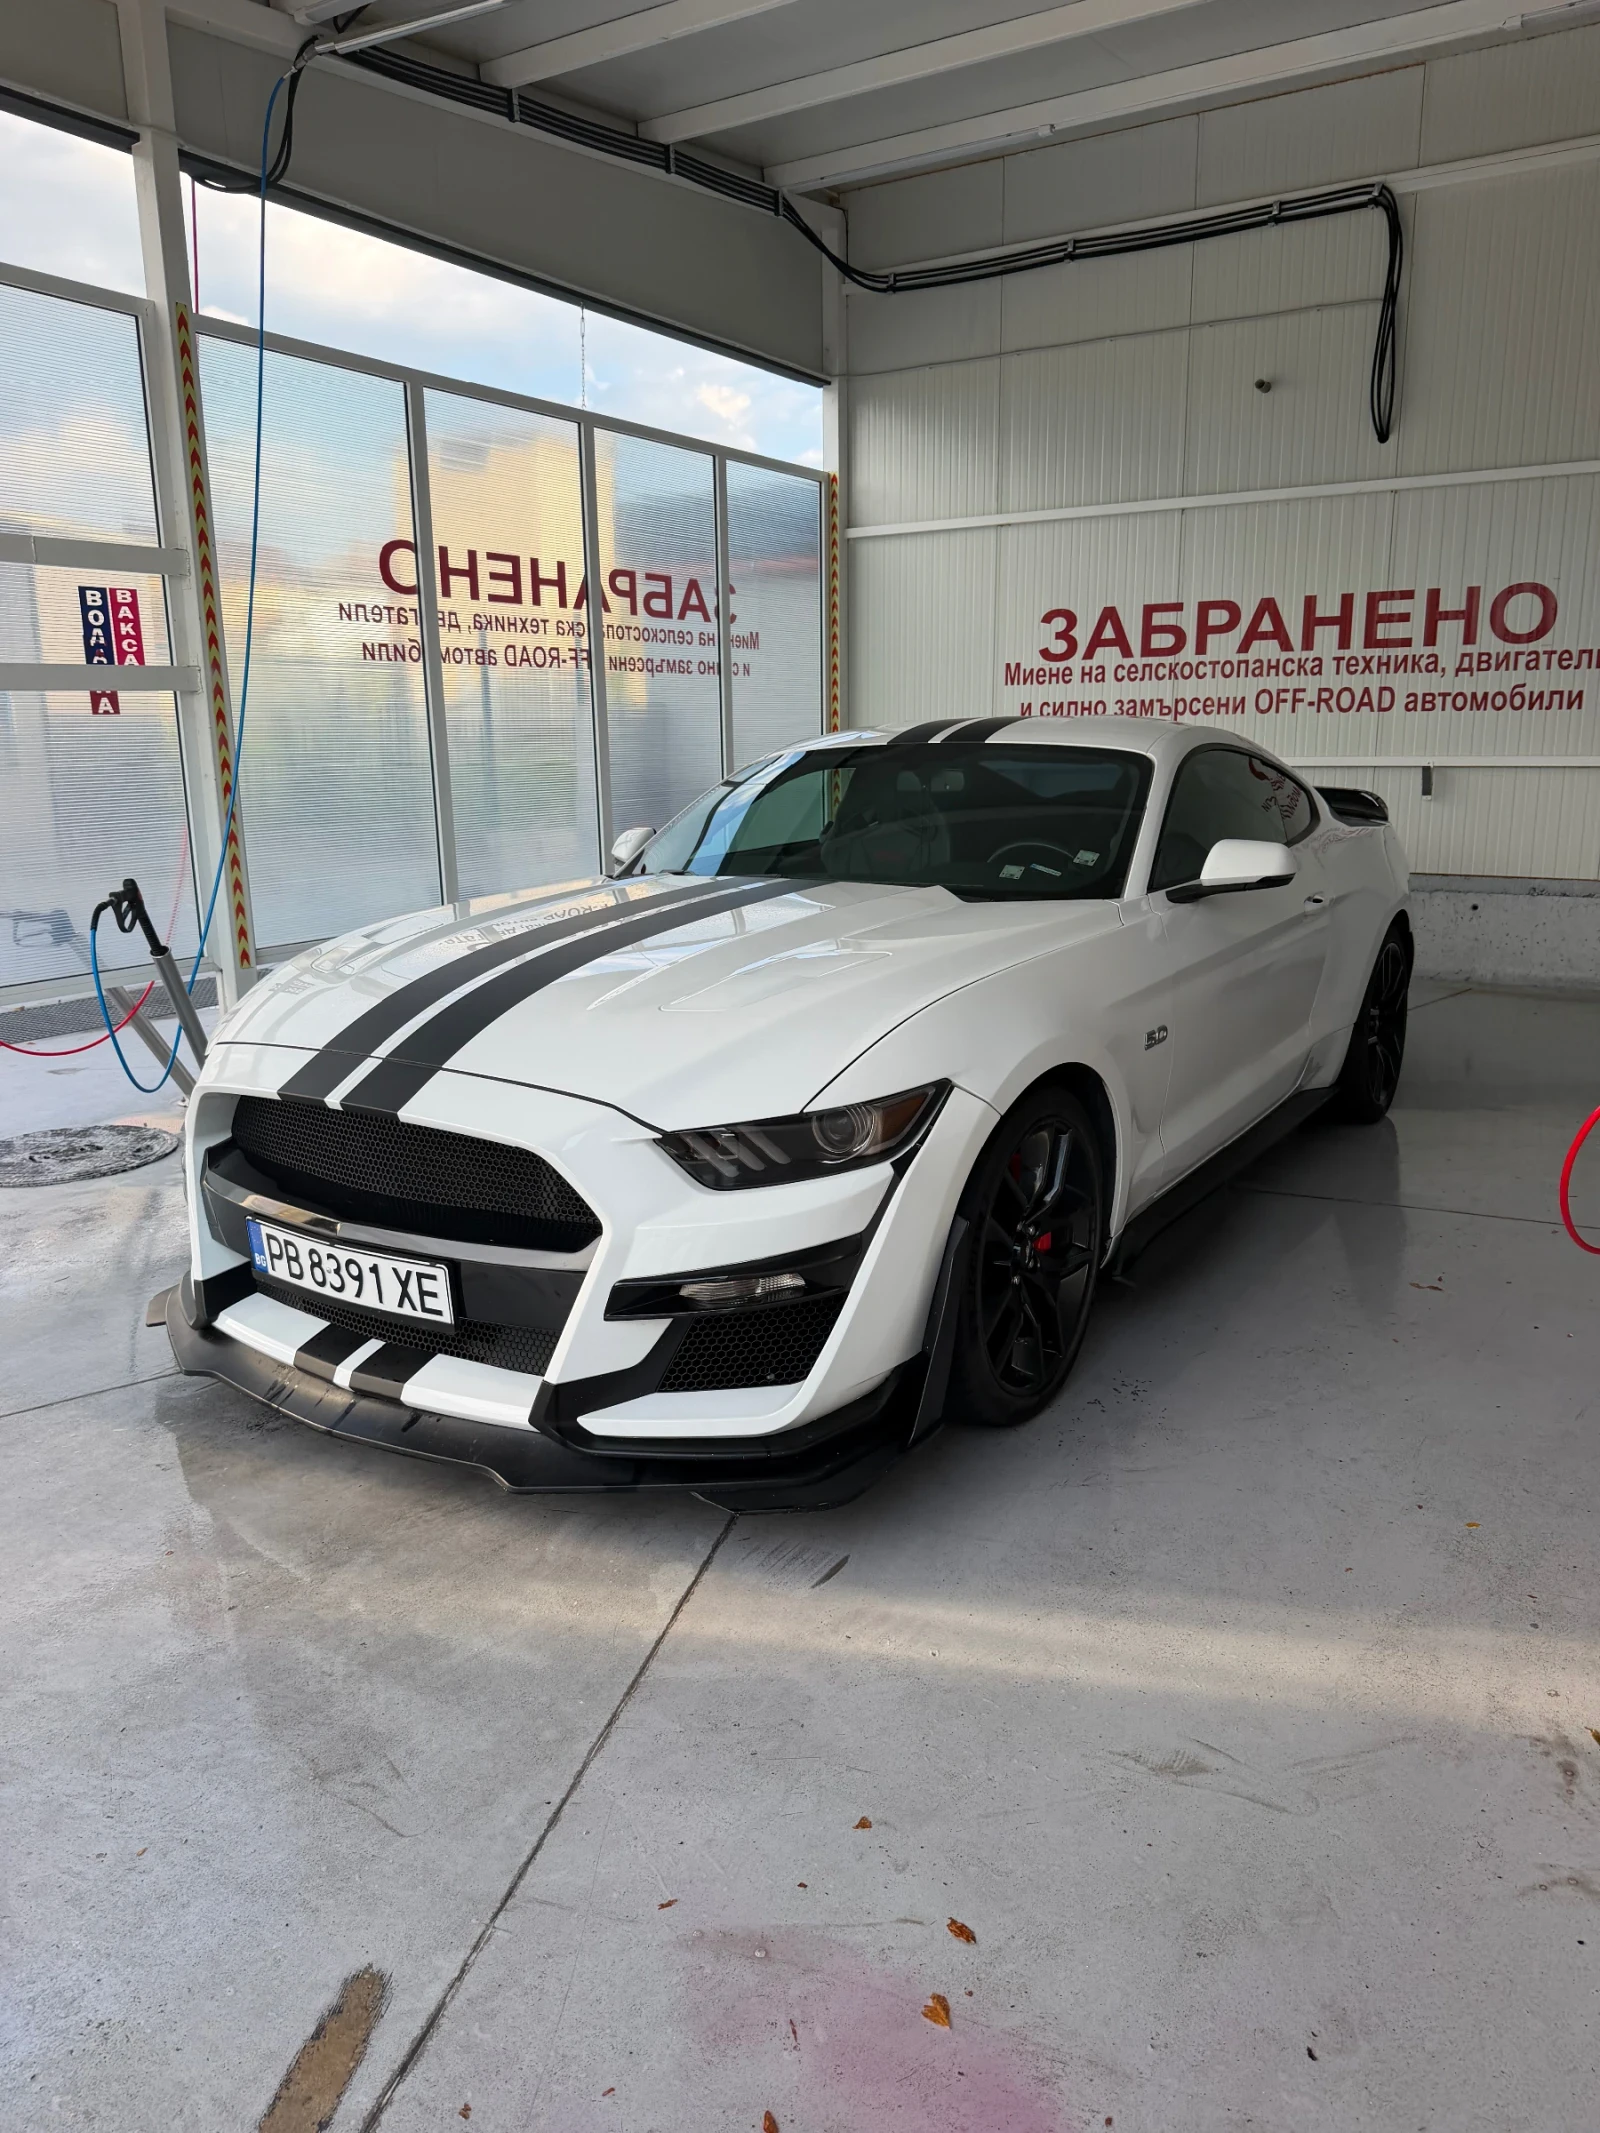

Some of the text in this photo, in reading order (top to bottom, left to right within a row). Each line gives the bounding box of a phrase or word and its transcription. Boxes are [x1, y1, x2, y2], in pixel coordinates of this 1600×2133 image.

[1038, 582, 1559, 662] ЗАБРАНЕНО
[1004, 648, 1600, 686] Миене на селскостопанска техника, двигател
[1020, 683, 1584, 722] и силно замърсени OFF-ROAD автомобили
[254, 1252, 267, 1267] BG
[265, 1232, 444, 1317] PB 8391 XE
